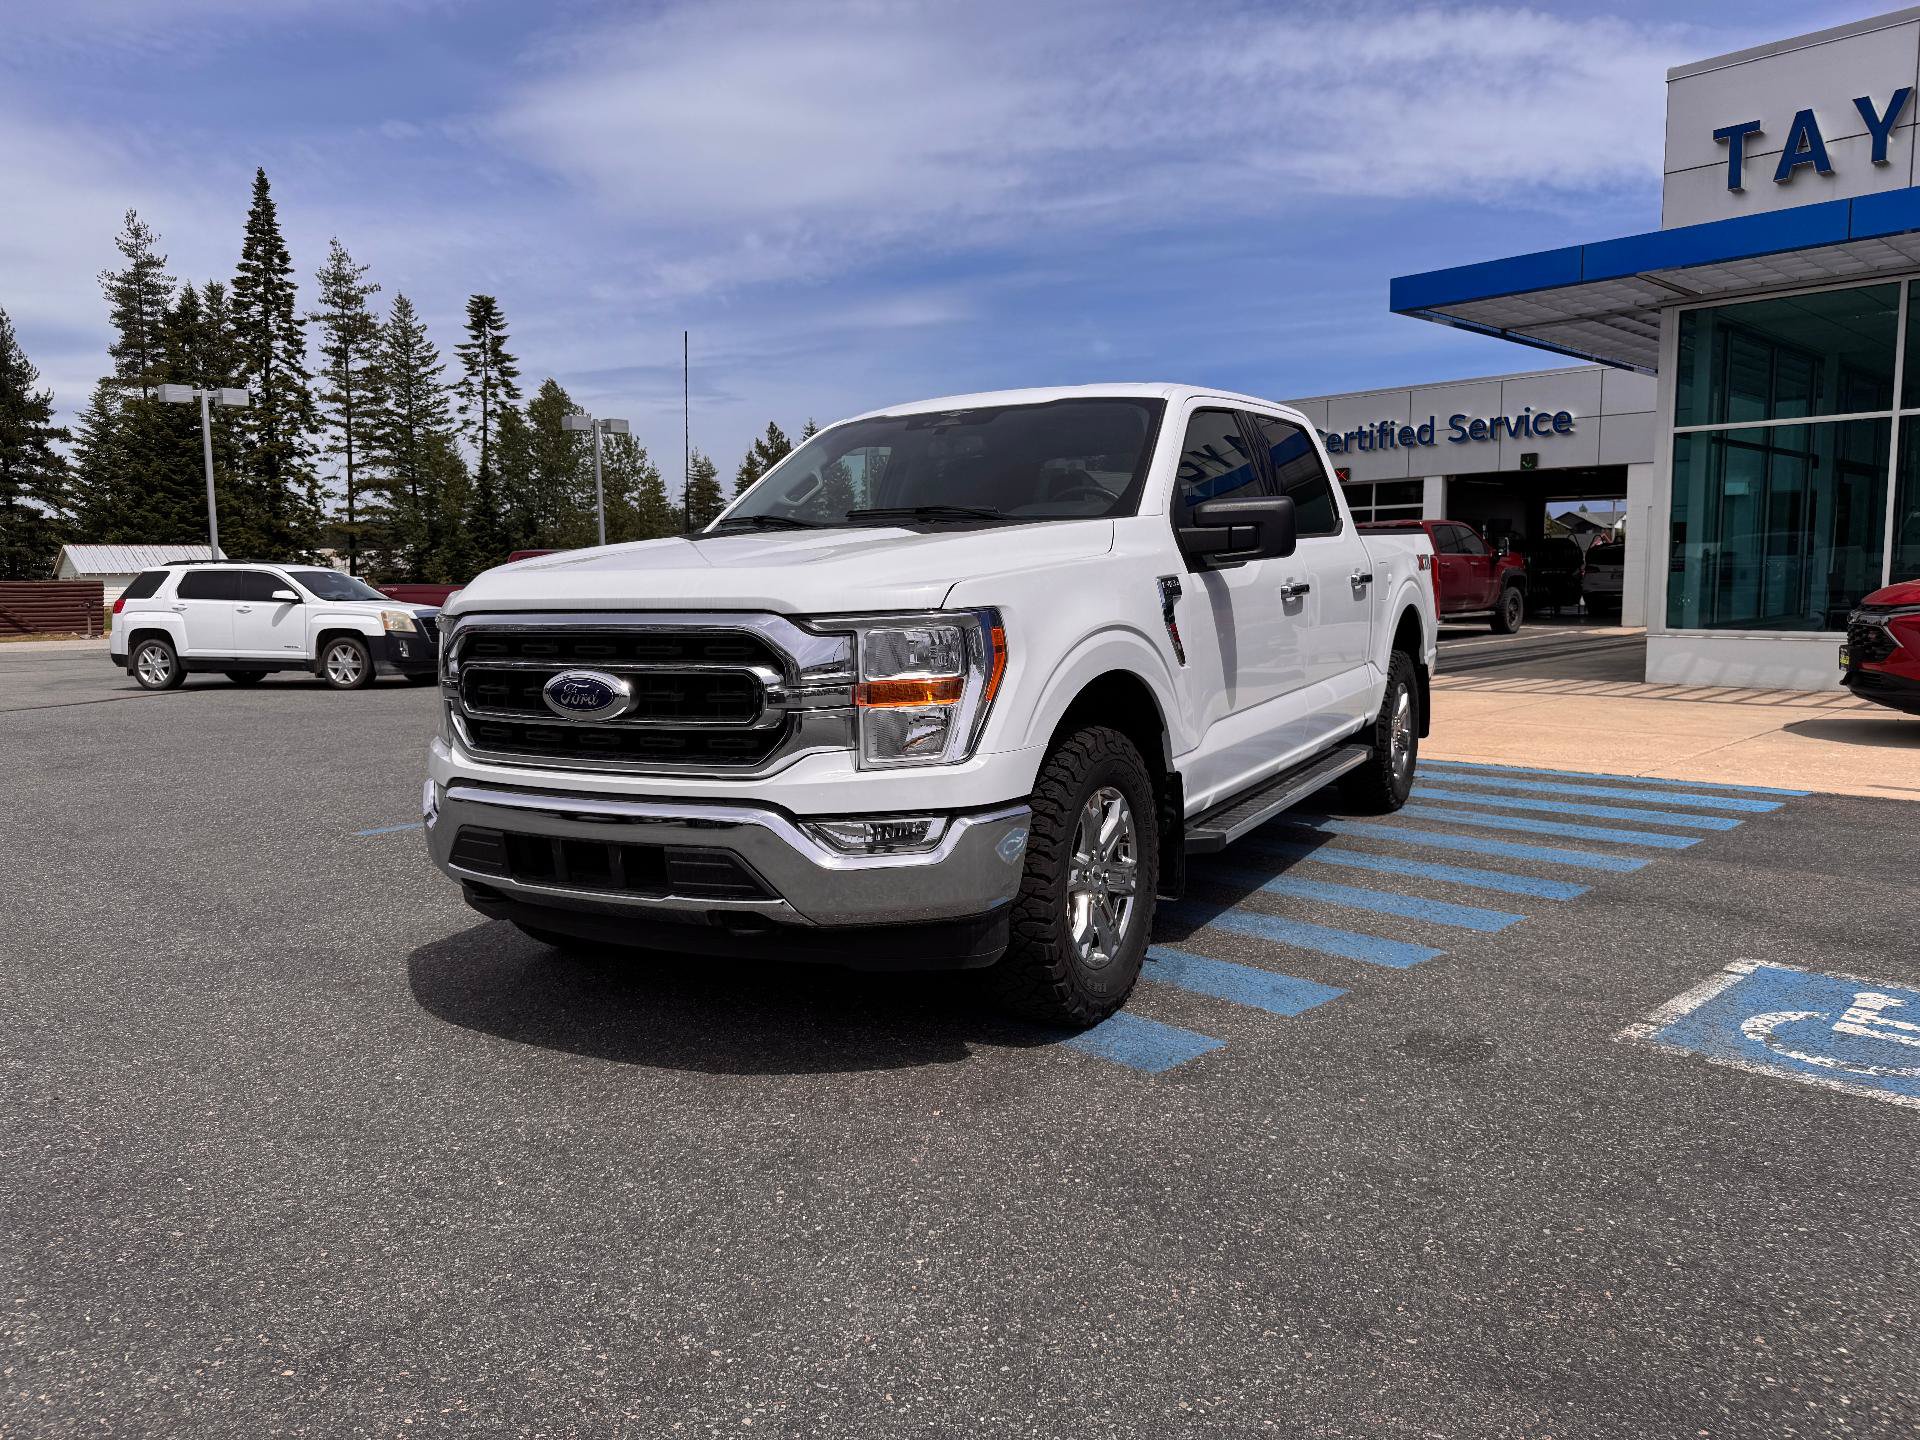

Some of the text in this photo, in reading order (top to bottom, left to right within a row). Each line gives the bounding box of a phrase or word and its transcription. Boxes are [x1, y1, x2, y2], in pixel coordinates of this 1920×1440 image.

[1713, 87, 1913, 191] TAY
[1316, 406, 1574, 453] ertified Service
[561, 682, 600, 706] Ford
